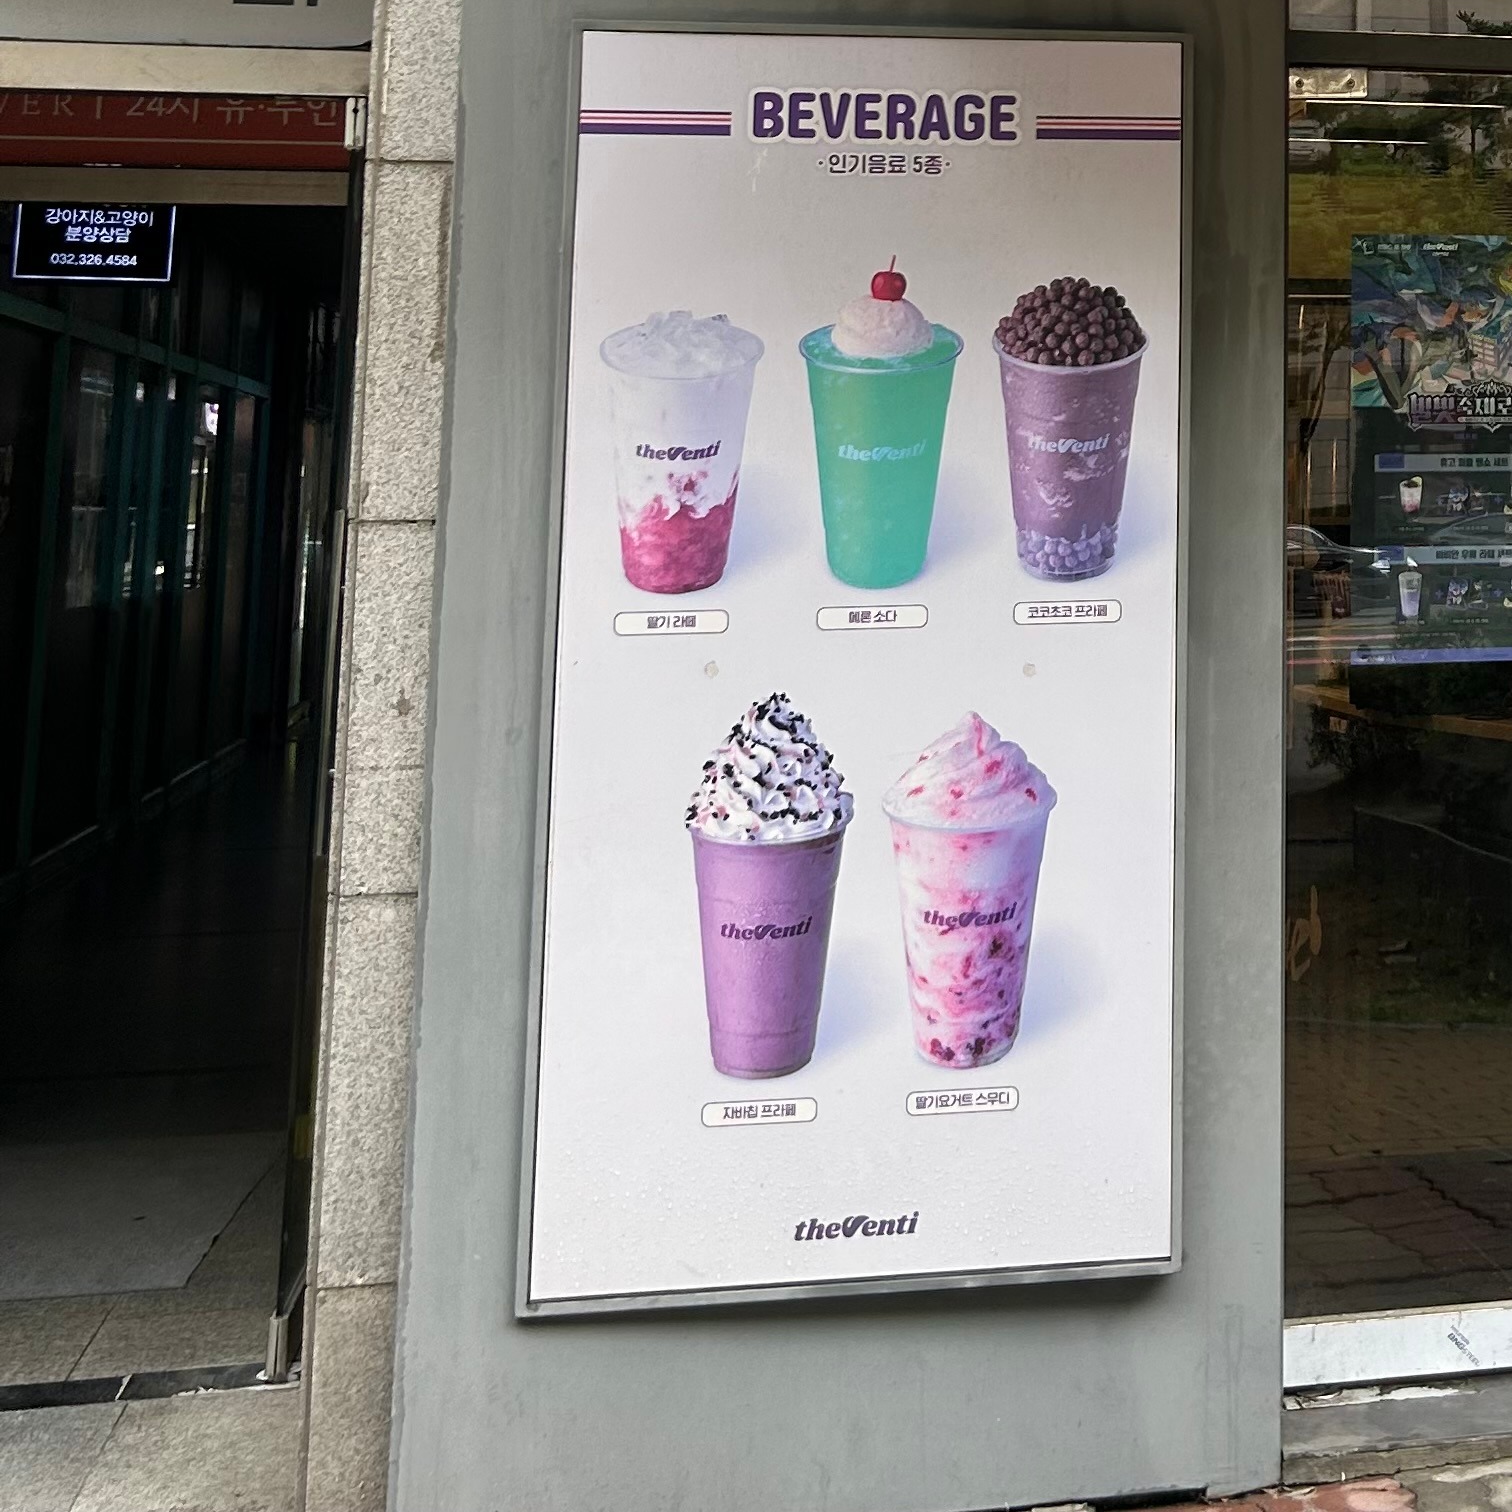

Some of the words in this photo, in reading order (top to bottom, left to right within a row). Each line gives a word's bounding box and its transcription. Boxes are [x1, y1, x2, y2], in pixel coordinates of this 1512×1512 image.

[0, 94, 76, 117] ER
[751, 89, 1019, 143] BEVERAGE
[45, 207, 154, 228] 강아지&고양이
[64, 225, 132, 244] 분양상담
[49, 252, 138, 267] 032.326.4584
[873, 610, 898, 624] 소다
[1027, 605, 1072, 620] 코코초코
[647, 615, 670, 629] 딸기
[915, 1093, 973, 1109] 딸기요거트
[975, 1091, 1010, 1107] 스무디
[723, 1104, 758, 1120] 자바칩
